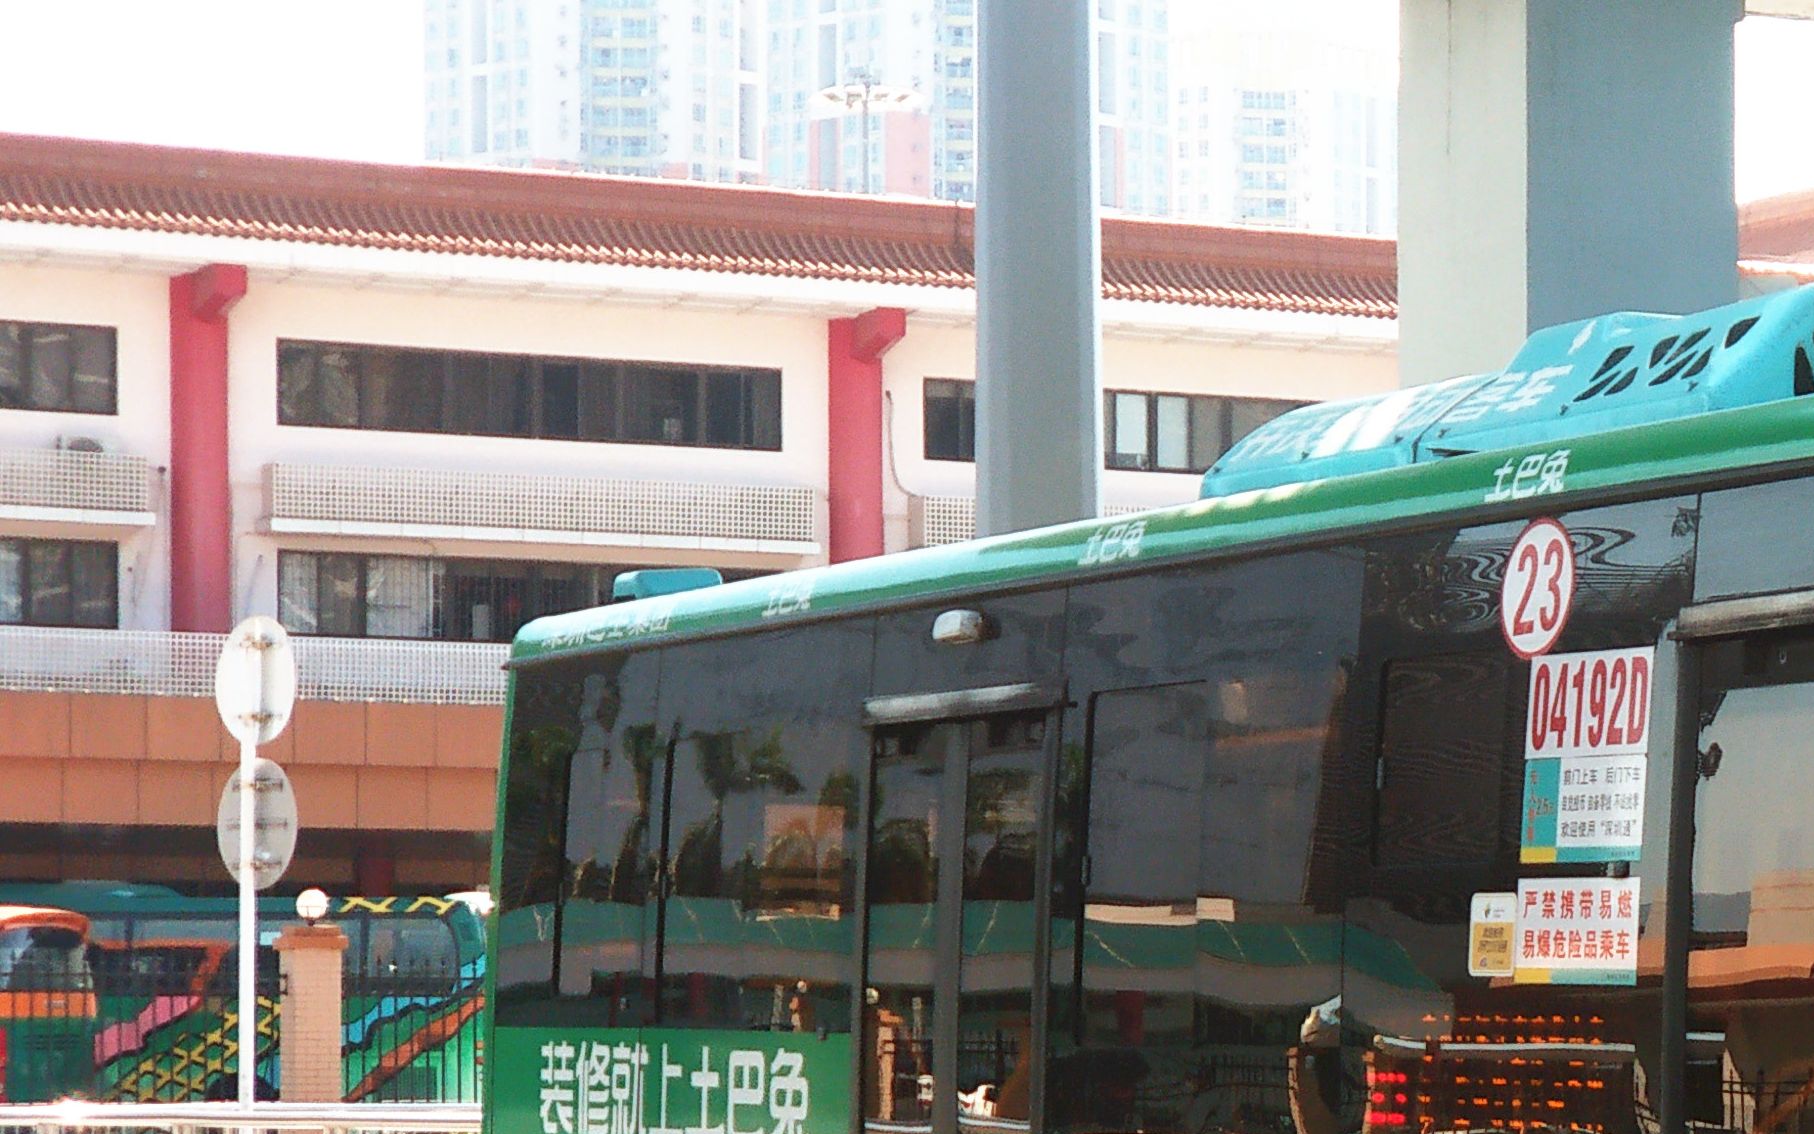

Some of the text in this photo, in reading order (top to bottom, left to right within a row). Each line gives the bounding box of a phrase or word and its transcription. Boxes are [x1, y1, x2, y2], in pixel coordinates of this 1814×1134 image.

[1484, 449, 1571, 502] 土巴兔
[1077, 520, 1148, 566] 土巴兔
[1514, 543, 1563, 637] 23
[1531, 655, 1649, 752] 04192D
[1522, 889, 1633, 920] 严禁携带易燃
[1522, 929, 1631, 960] 易爆危险品乘车
